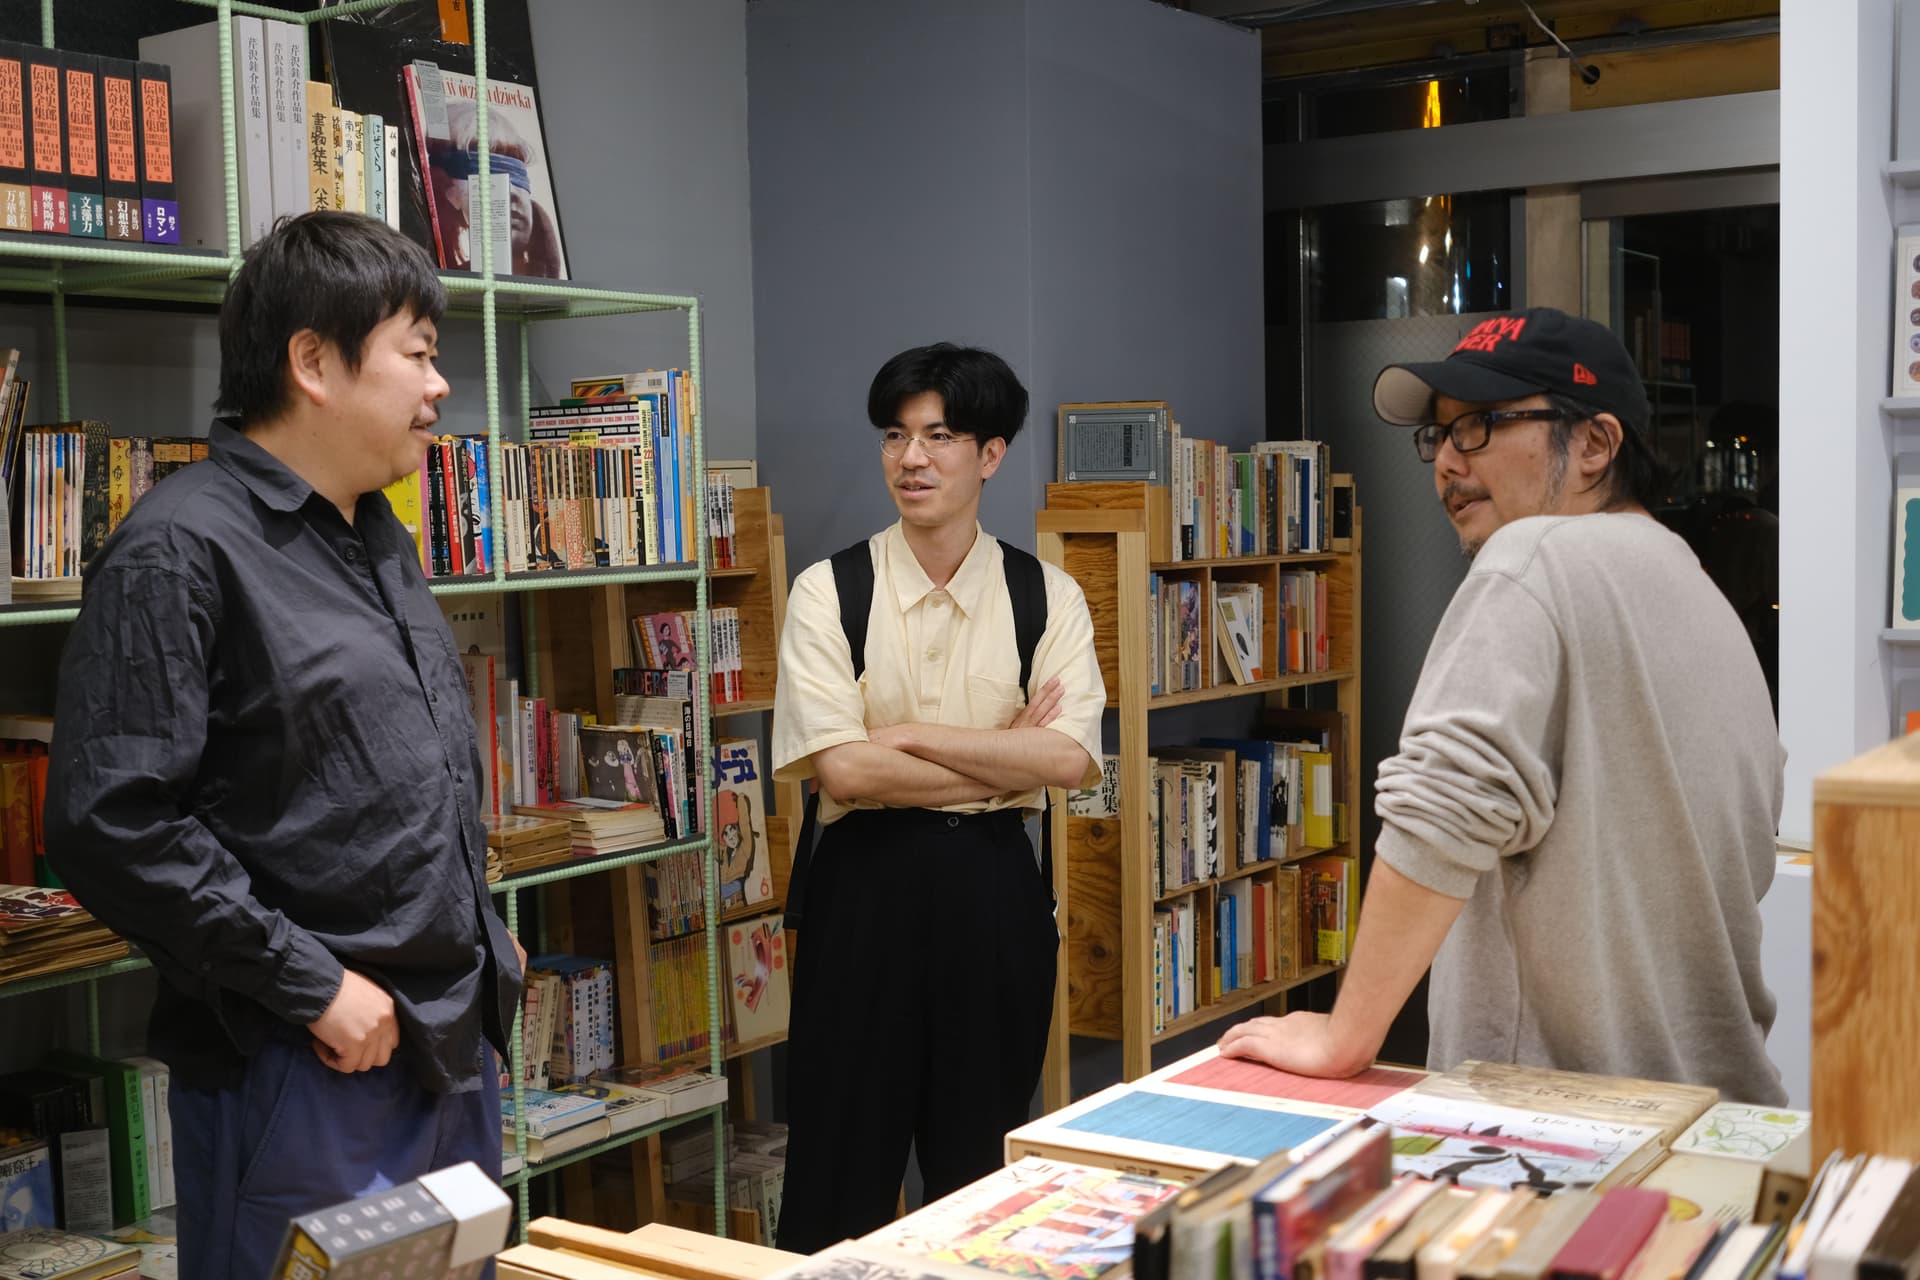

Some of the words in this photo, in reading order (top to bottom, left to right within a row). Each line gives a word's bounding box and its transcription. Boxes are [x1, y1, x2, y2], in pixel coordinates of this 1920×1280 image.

[44, 68, 57, 121] 国枝史郎
[79, 73, 92, 126] 国枝史郎
[118, 81, 131, 132] 国枝史郎
[156, 82, 168, 132] 国枝史郎
[493, 85, 531, 109] dziecka
[156, 206, 168, 237] ロマン
